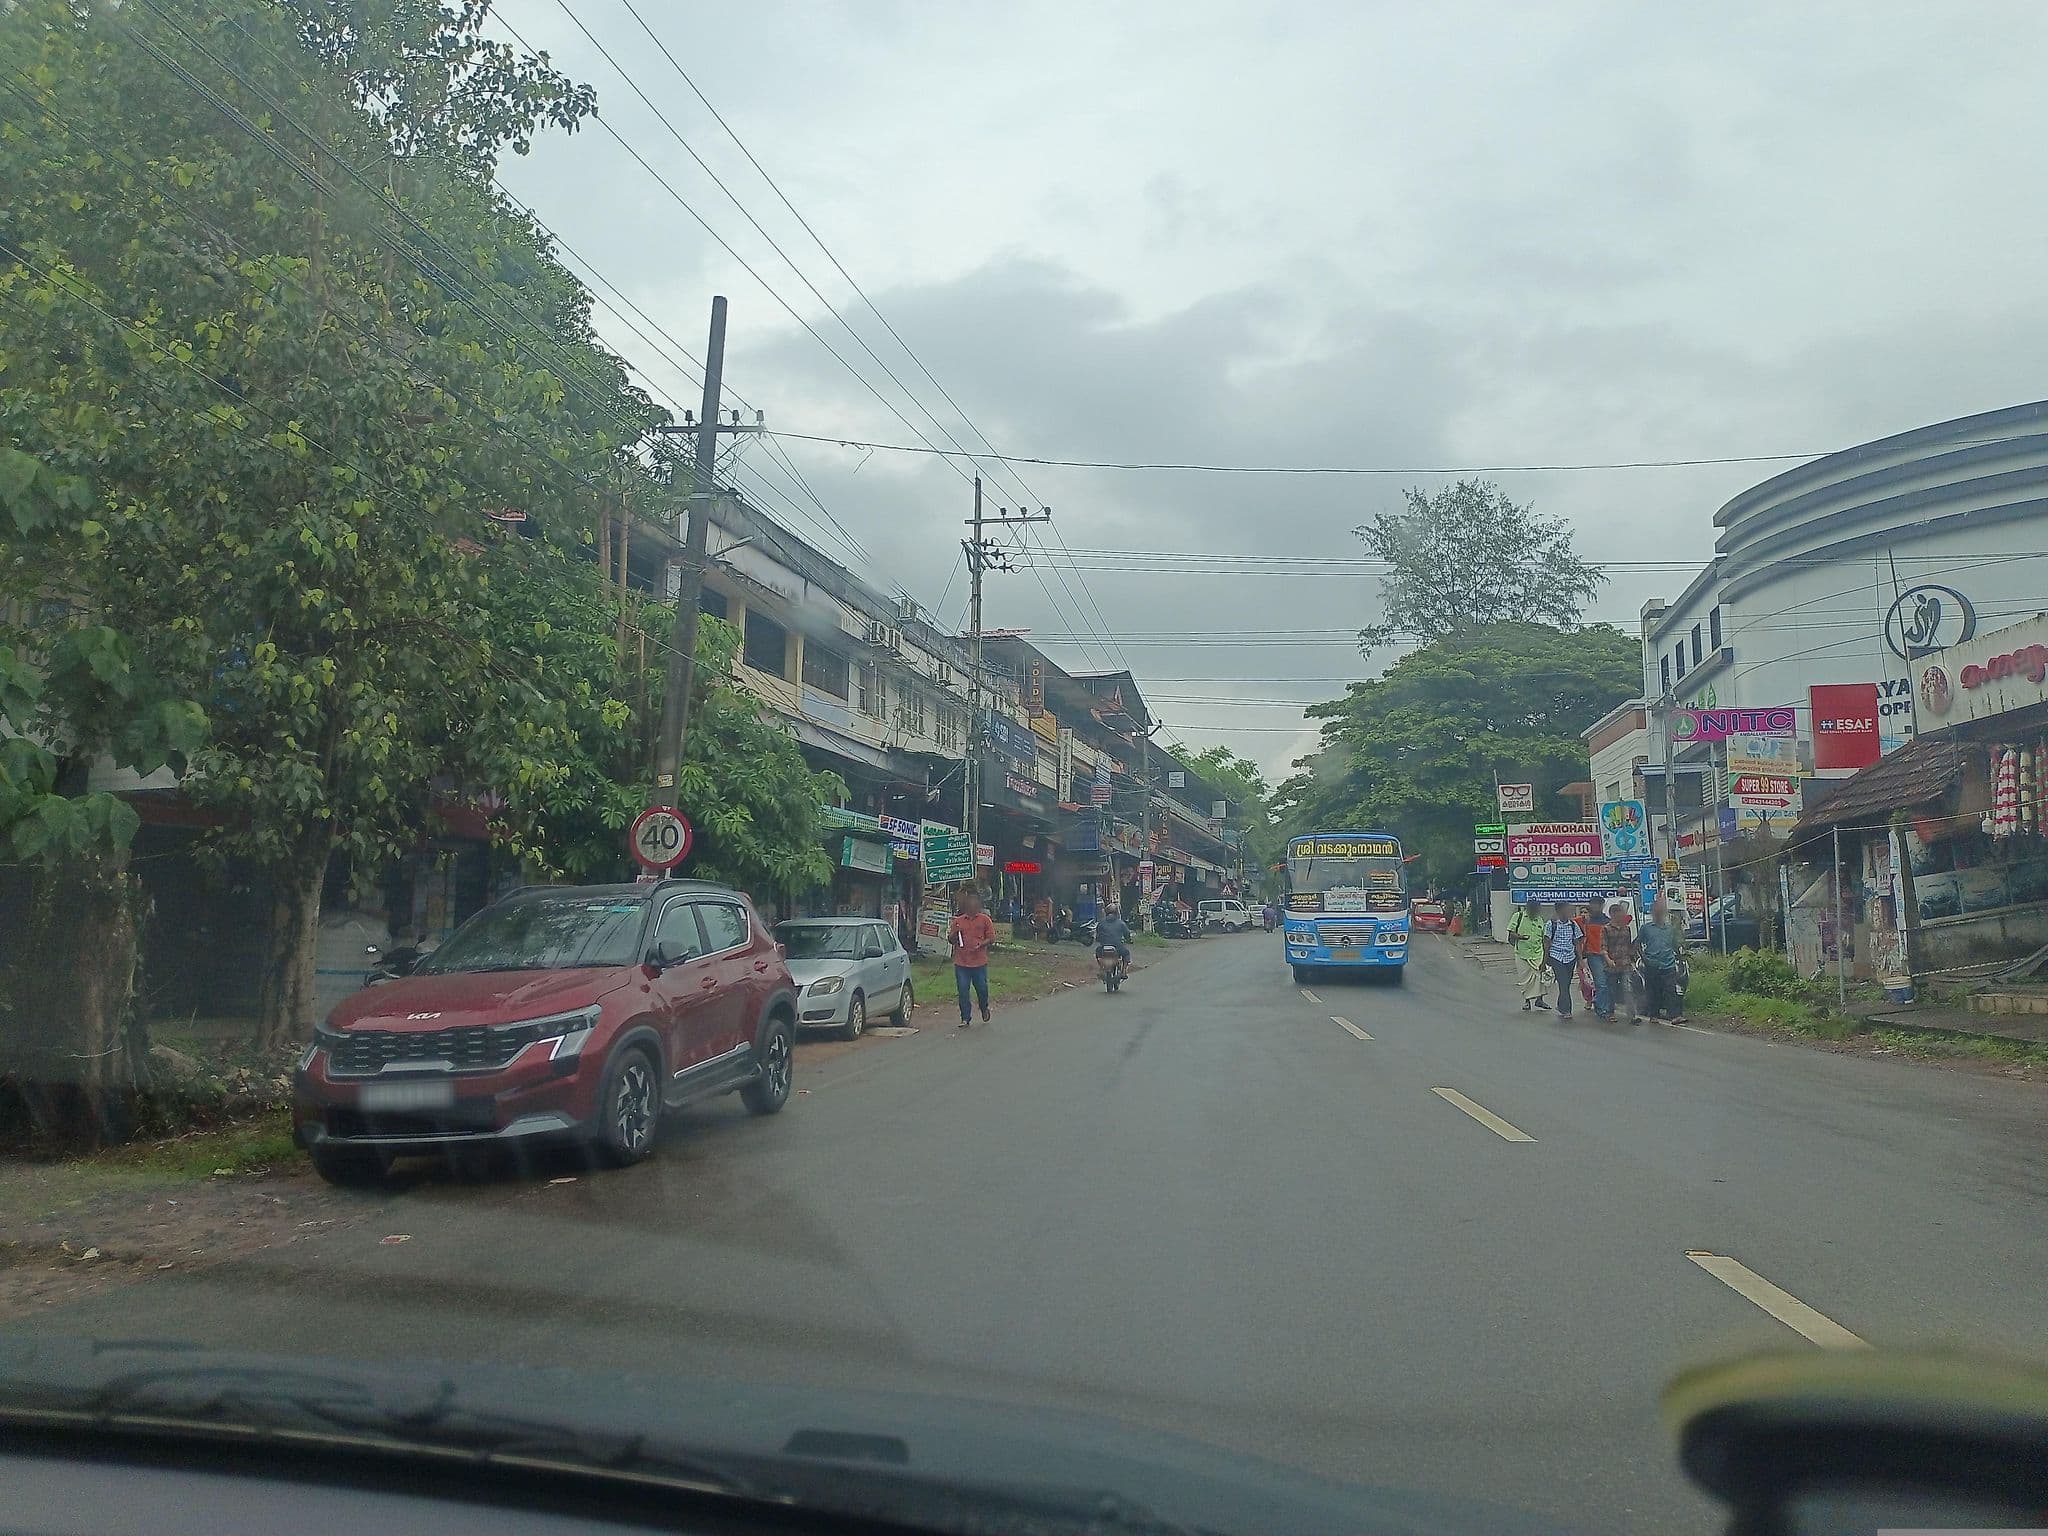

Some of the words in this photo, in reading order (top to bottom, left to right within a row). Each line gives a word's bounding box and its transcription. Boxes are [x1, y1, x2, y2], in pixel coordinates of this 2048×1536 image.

[1702, 710, 1794, 733] NITC
[1836, 718, 1873, 730] ESAF
[1741, 778, 1760, 793] SUPER
[1760, 776, 1769, 793] 99
[1769, 779, 1788, 794] STORE
[641, 824, 679, 850] 40
[1527, 824, 1593, 835] JAYAMOHAN
[1296, 840, 1315, 858] ശ്രീ
[1513, 841, 1592, 856] കണ്ണടകൾ
[1526, 890, 1566, 898] LAKSHMI
[1568, 890, 1604, 898] DENTAL
